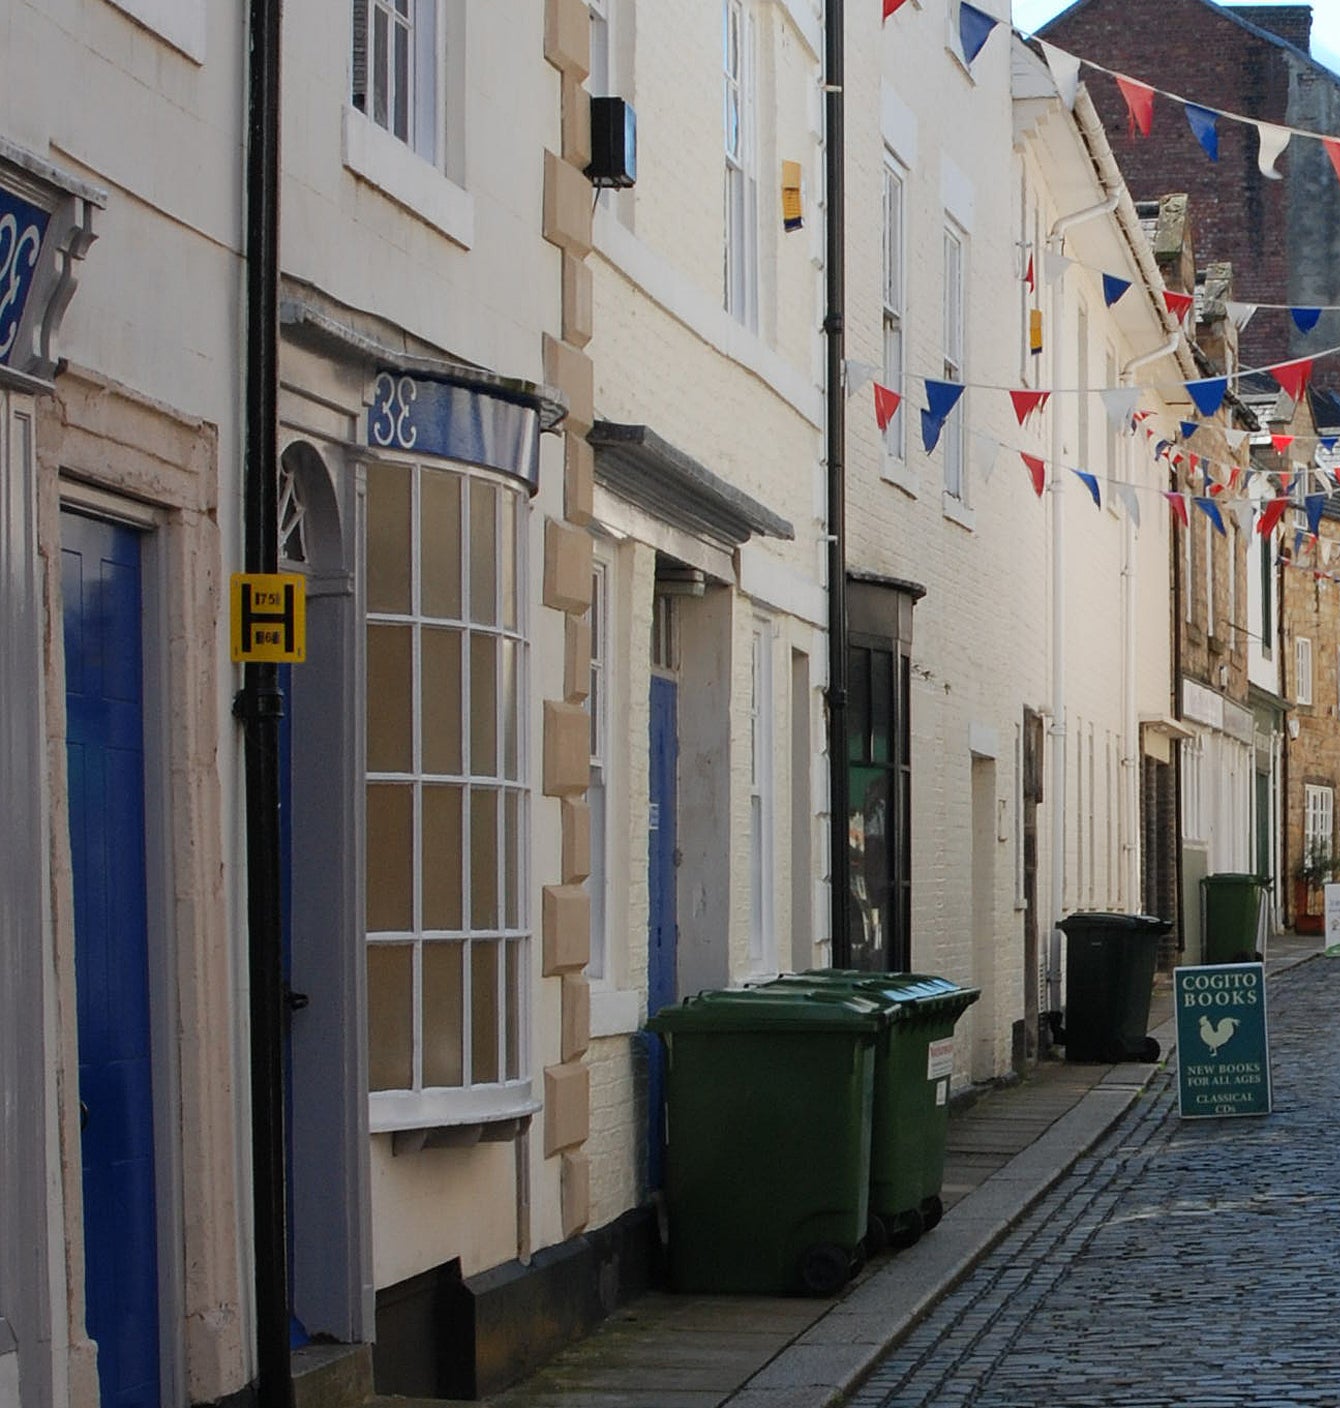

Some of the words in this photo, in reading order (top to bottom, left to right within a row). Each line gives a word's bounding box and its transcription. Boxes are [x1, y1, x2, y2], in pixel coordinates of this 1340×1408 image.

[1182, 973, 1257, 991] COGITO
[1184, 989, 1257, 1007] BOOKS
[1187, 1065, 1215, 1076] NEW
[1218, 1063, 1260, 1074] BOOKS
[1187, 1076, 1209, 1087] FOR
[1211, 1075, 1231, 1086] ALL
[1234, 1073, 1261, 1084] AGES
[1196, 1092, 1255, 1104] CLASSICAL
